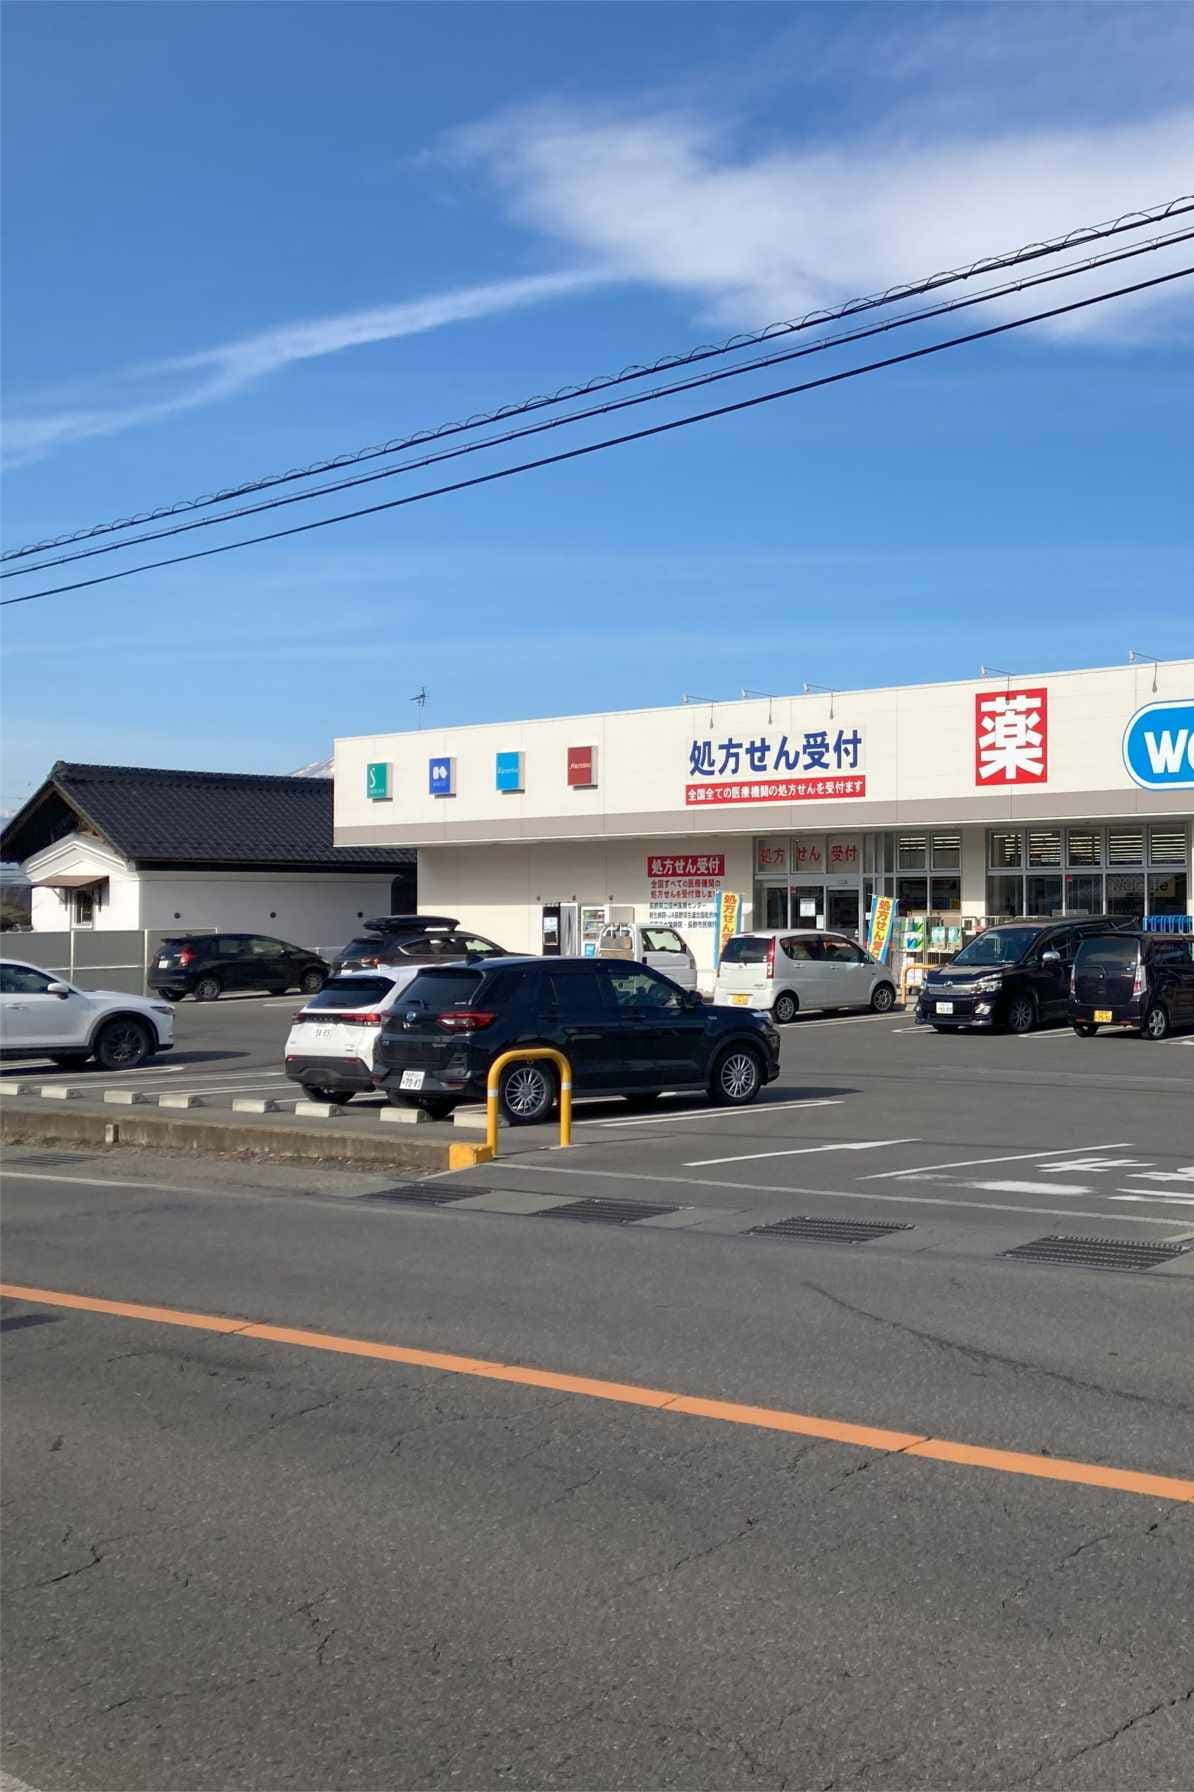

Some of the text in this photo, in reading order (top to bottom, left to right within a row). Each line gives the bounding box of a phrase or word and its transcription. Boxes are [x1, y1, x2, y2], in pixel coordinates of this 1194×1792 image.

[689, 729, 862, 776] 処方せん受付
[978, 694, 1044, 779] 薬
[651, 857, 720, 874] 処方せん受付
